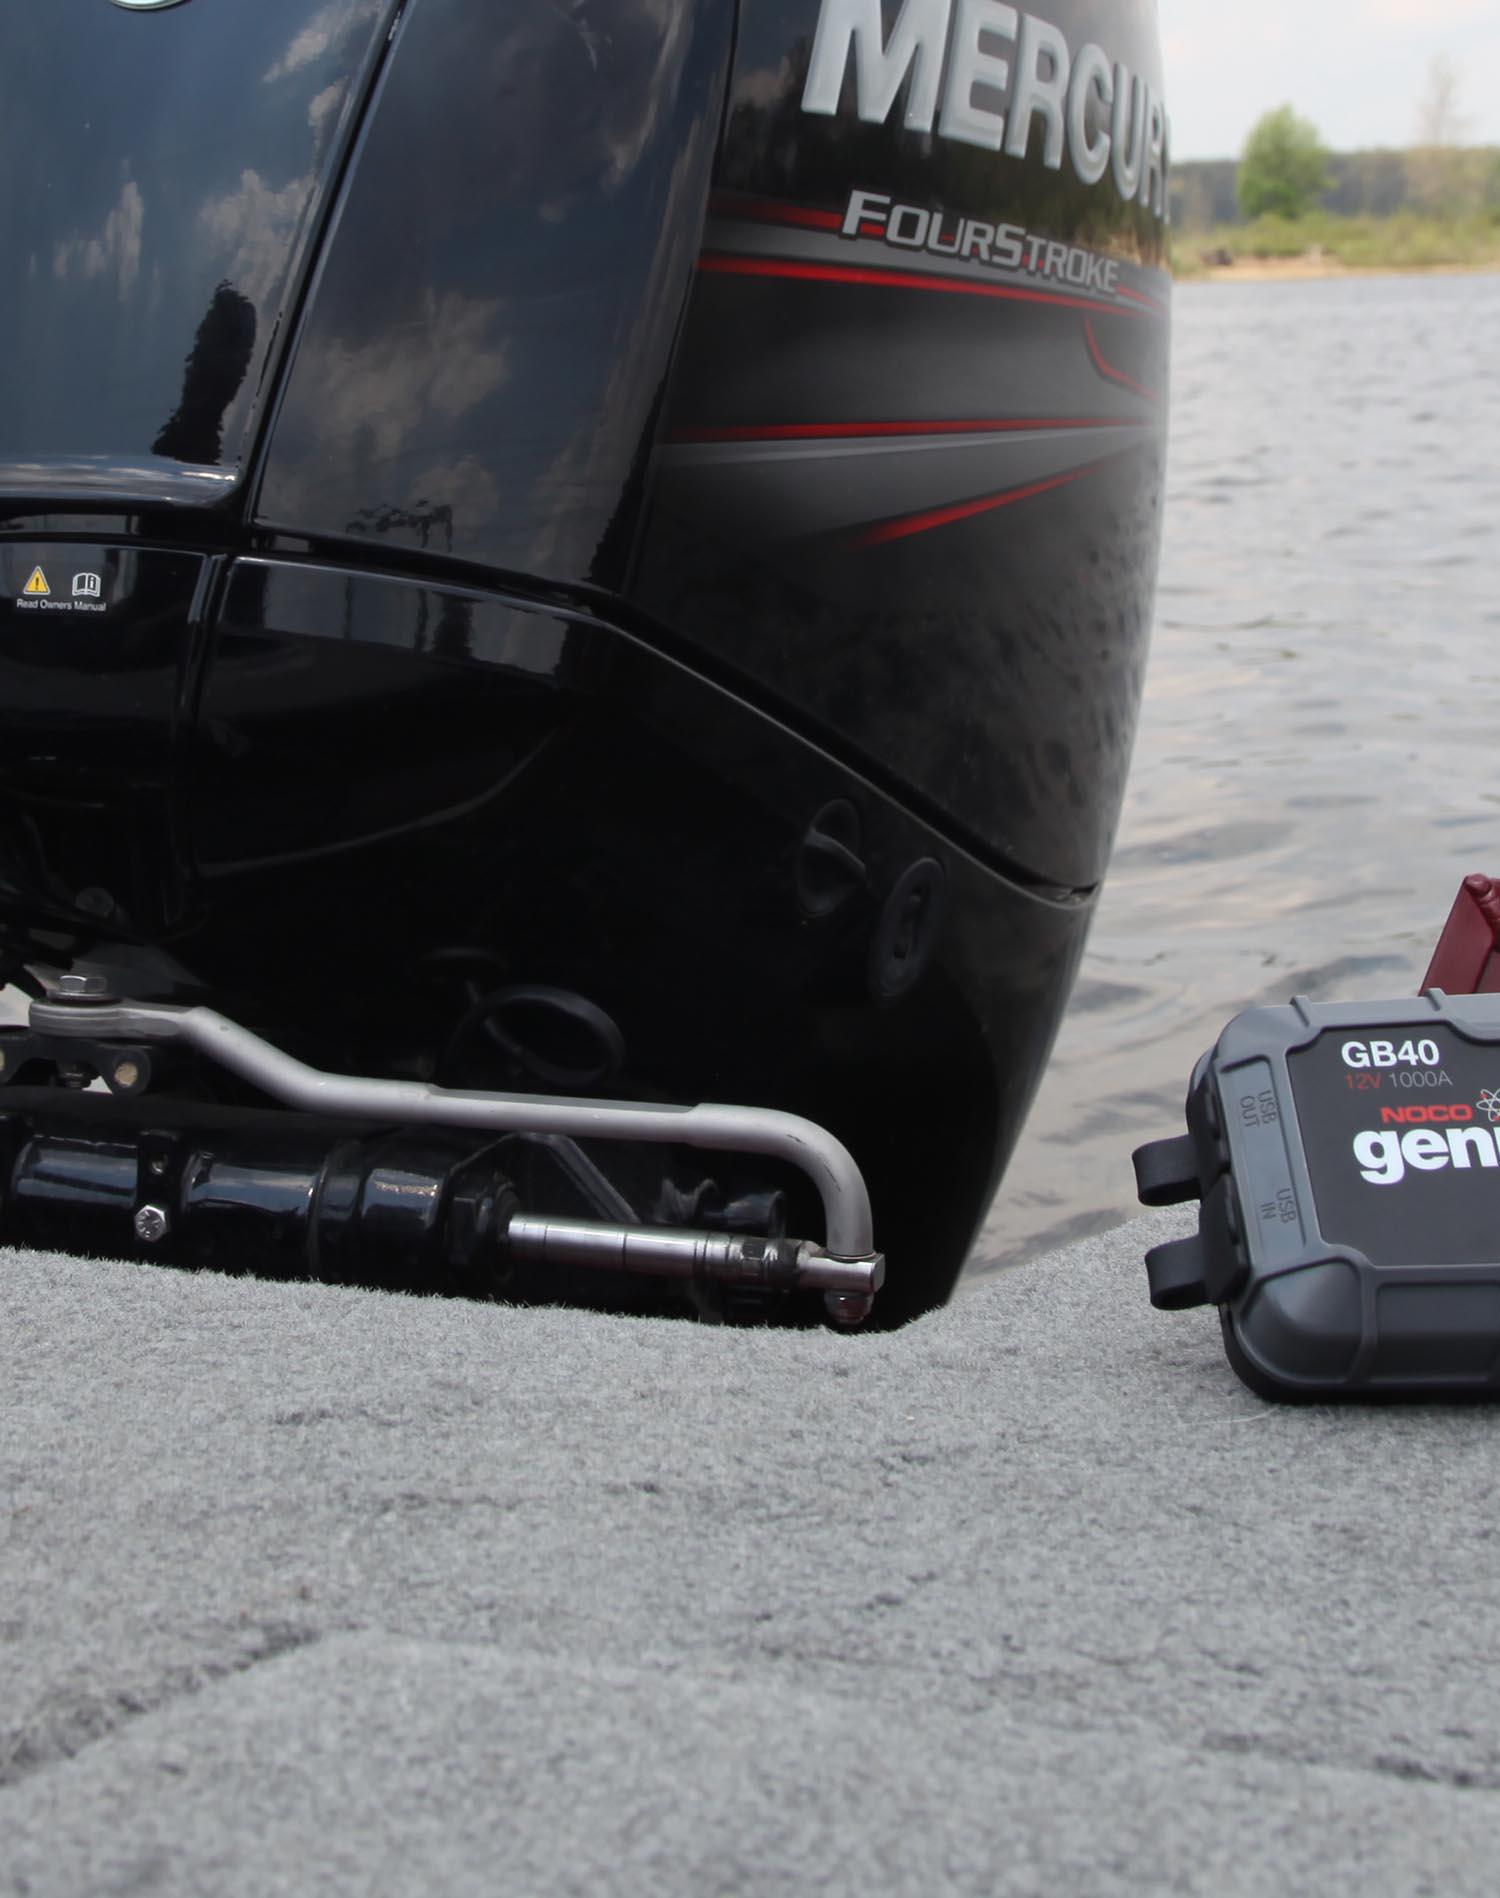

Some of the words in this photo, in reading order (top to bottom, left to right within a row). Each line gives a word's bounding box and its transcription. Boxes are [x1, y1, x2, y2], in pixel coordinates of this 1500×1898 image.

[17, 599, 38, 608] Read
[40, 600, 72, 610] Owners
[74, 601, 106, 611] Manual
[1341, 1039, 1440, 1069] GB40
[1345, 1073, 1382, 1090] 12V
[1388, 1070, 1453, 1088] 1000A
[1240, 1095, 1260, 1127] OUT
[1258, 1089, 1278, 1124] USB
[1381, 1103, 1474, 1124] NOCO
[1260, 1201, 1276, 1220] IN
[1276, 1188, 1297, 1224] USB
